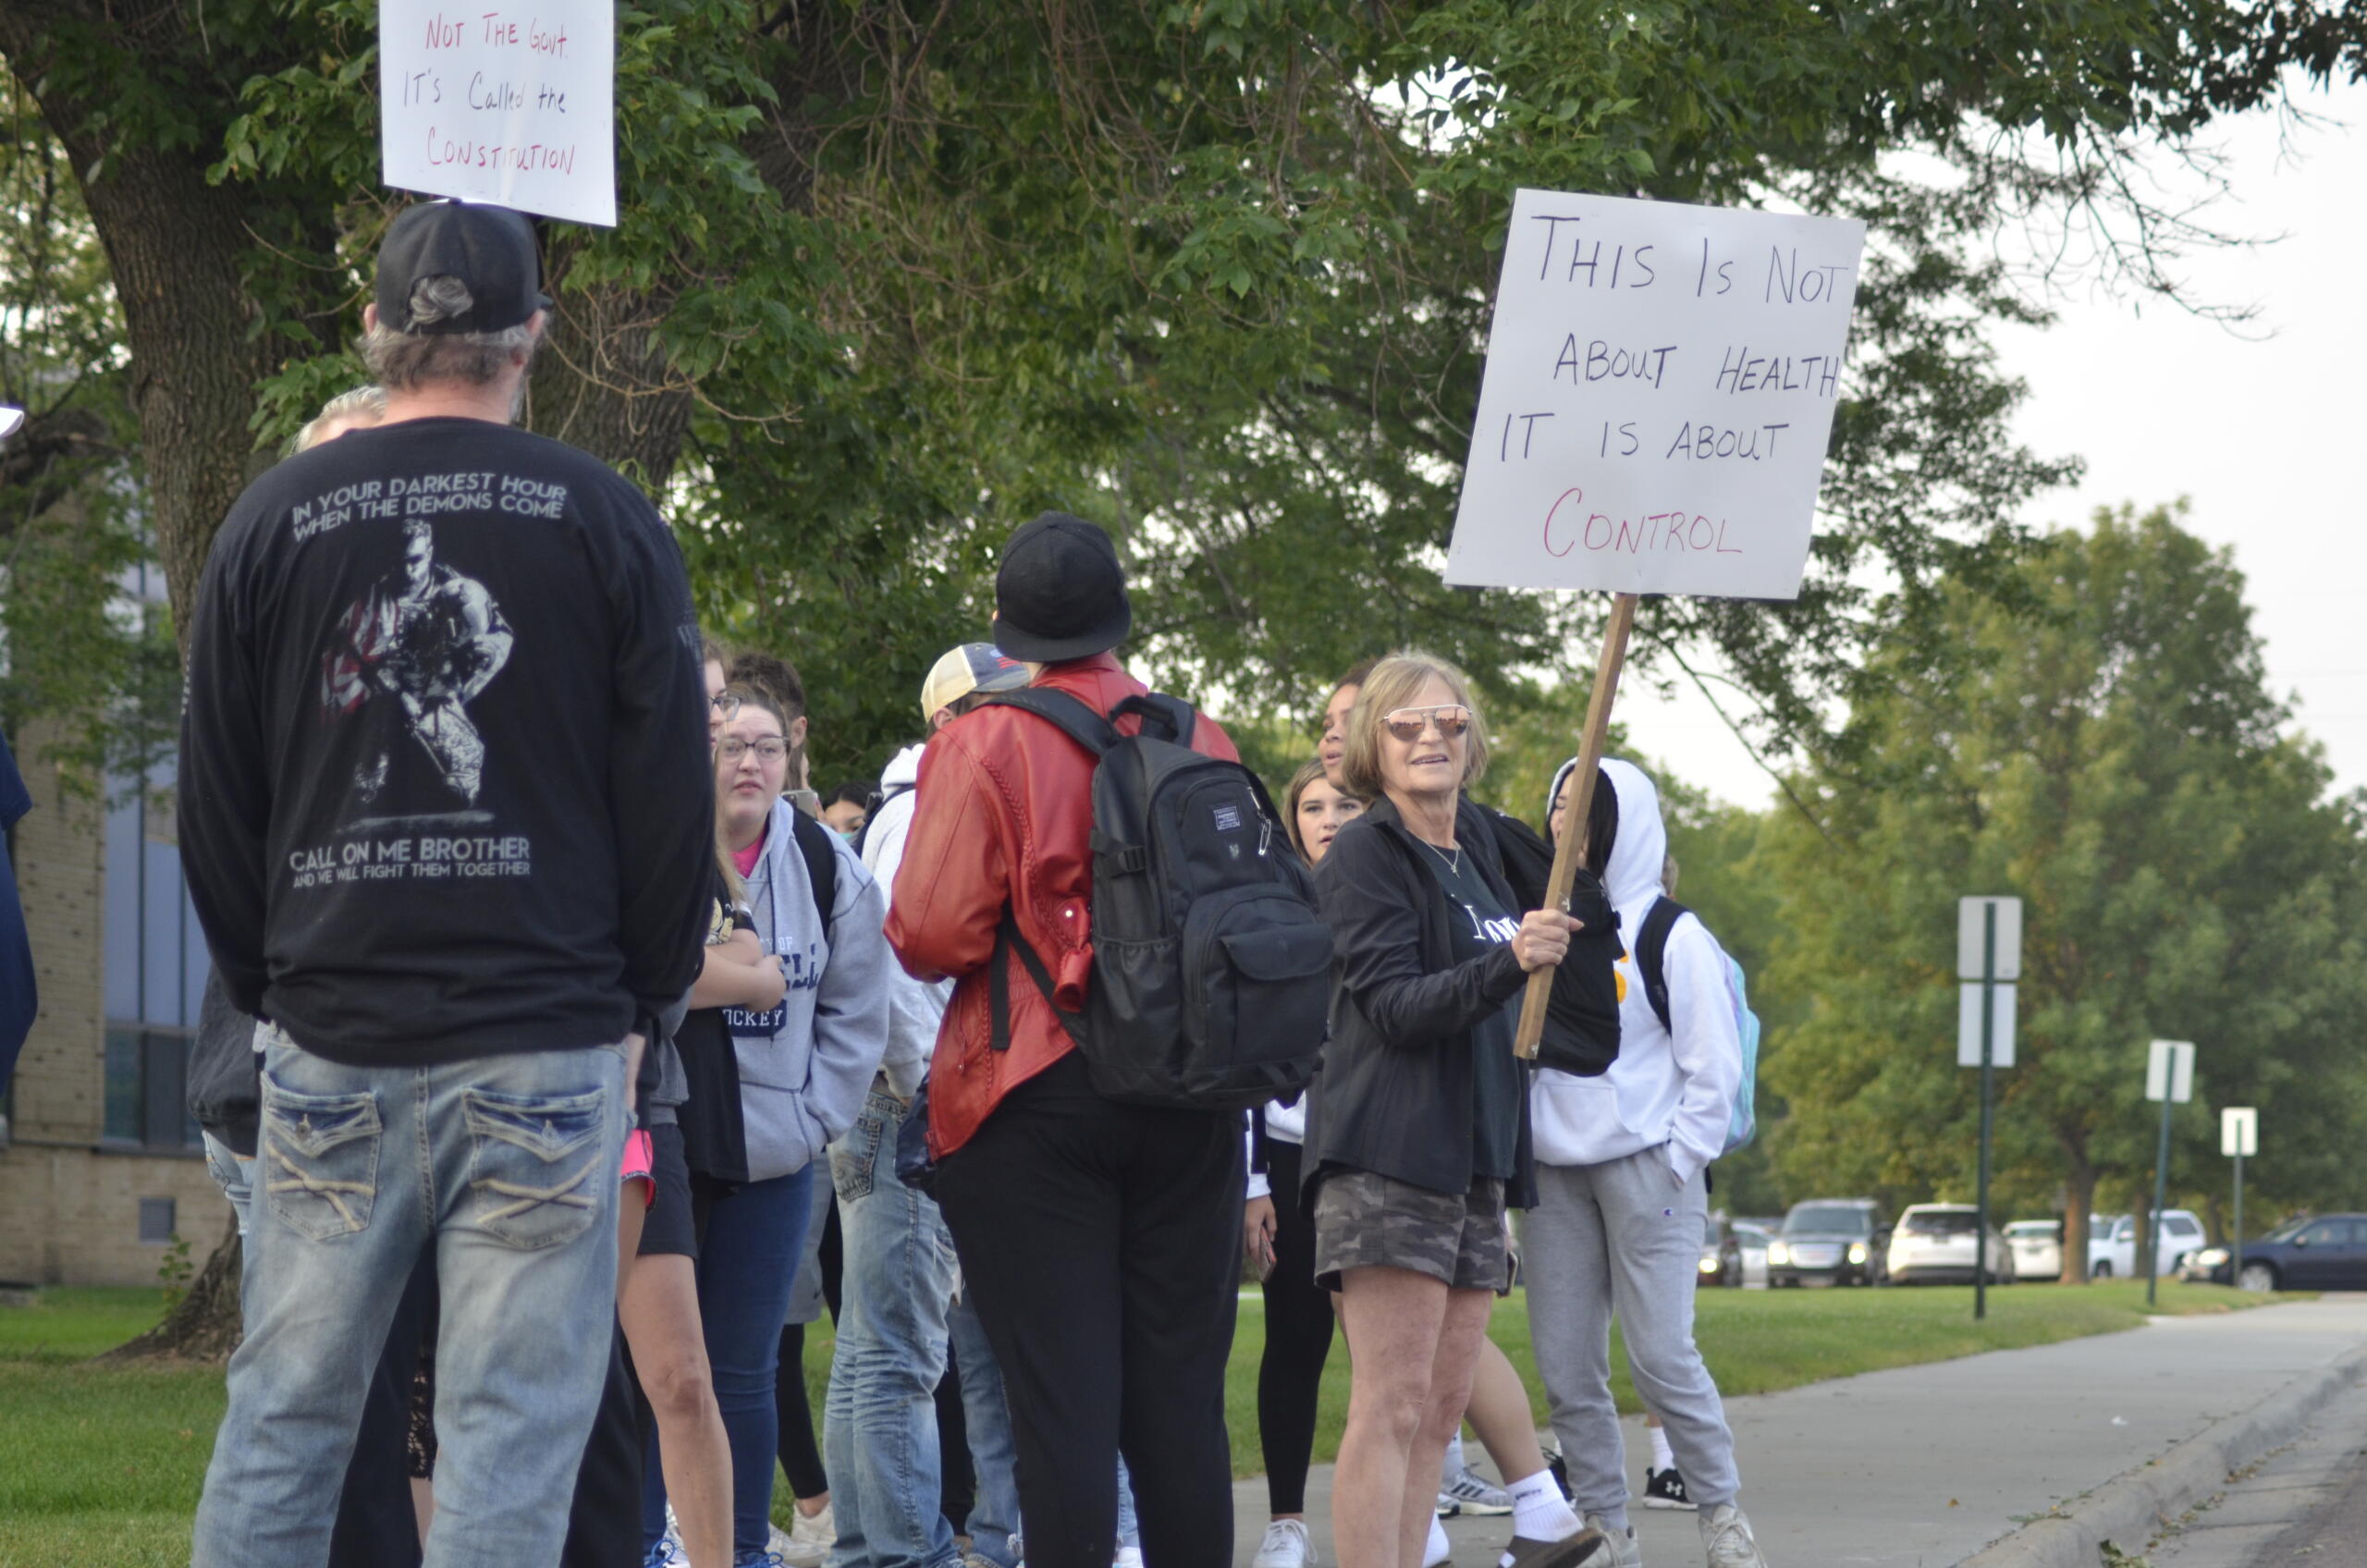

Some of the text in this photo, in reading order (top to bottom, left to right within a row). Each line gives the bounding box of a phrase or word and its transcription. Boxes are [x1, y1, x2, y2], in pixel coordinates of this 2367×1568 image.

[425, 13, 464, 48] NOT
[483, 13, 518, 47] THE
[404, 67, 566, 113] IT'S Called the
[427, 126, 575, 175] CONSTITUTION
[1531, 215, 1655, 288] THIS
[1766, 245, 1848, 303] NOT
[1553, 333, 1839, 397] ABOUT HEALTH
[1501, 413, 1789, 461] IT IS ABOUT
[292, 472, 567, 526] IN YOUR DARKEST HOUR
[293, 492, 564, 543] WHEN THE DEMONS COME
[1543, 487, 1743, 557] CONTROL
[289, 837, 530, 872] CALL ON ME BROTHER
[293, 860, 531, 888] AND WE WILL FIGHT THEM TOGETHER
